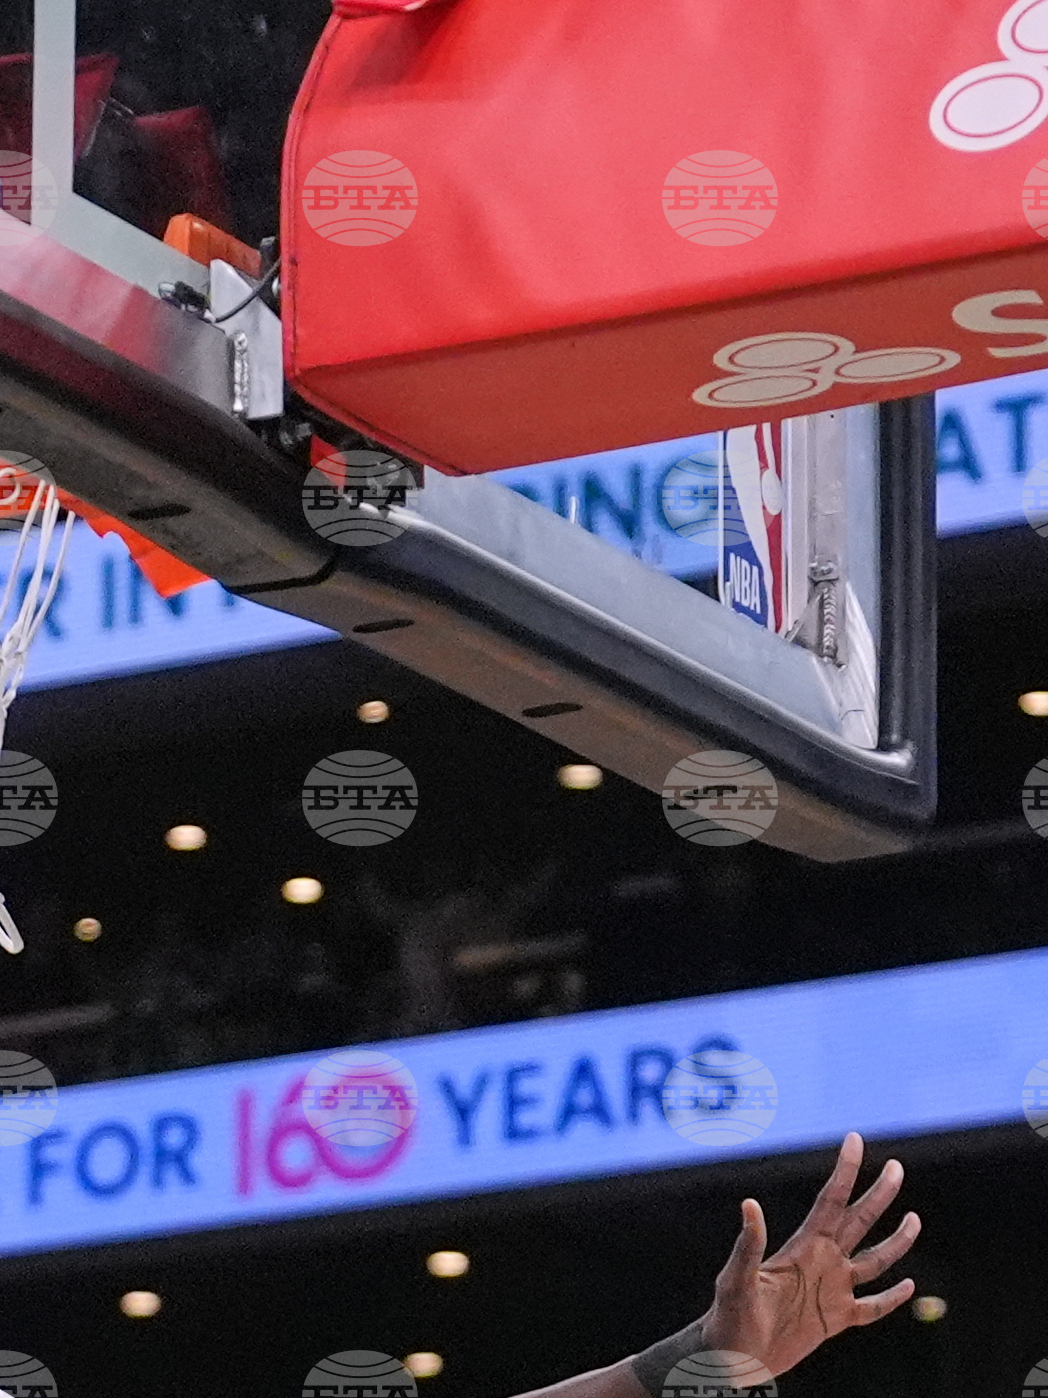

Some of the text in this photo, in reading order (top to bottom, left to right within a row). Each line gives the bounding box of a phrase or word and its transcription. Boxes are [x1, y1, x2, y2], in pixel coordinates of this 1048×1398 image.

[728, 552, 762, 615] NBA
[27, 1112, 201, 1206] FOR
[235, 1064, 416, 1194] 160
[436, 1033, 740, 1150] YEARS
